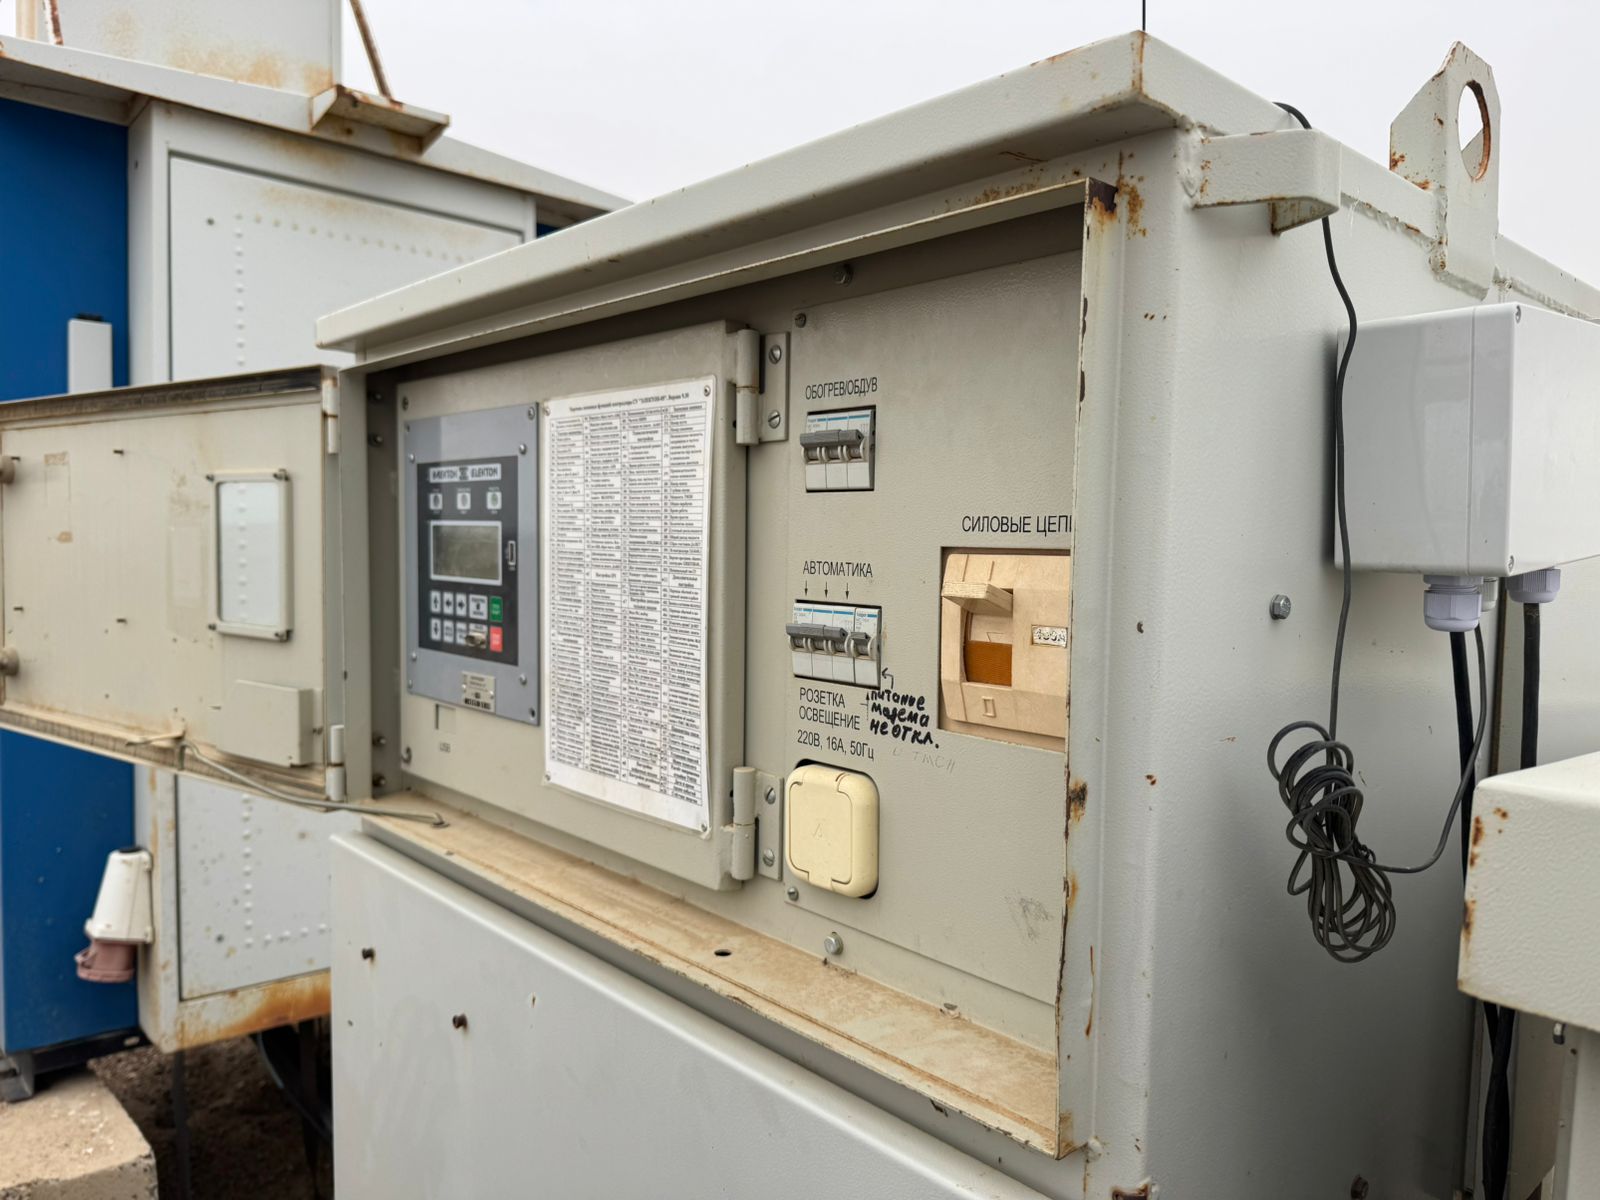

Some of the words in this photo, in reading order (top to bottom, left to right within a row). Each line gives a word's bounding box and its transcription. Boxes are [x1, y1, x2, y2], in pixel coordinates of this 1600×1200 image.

[805, 376, 878, 400] ОБОГРЕВ/ОБДУВ
[962, 515, 1032, 533] СИЛОВЫЕ
[802, 560, 873, 577] АВТОМАТИКА
[799, 687, 846, 708] РОЗЕТКА
[799, 705, 860, 730] ОСВЕЩЕНИЕ
[797, 729, 823, 750] 220В,
[826, 736, 847, 755] 16А,
[850, 740, 875, 761] 50Гц
